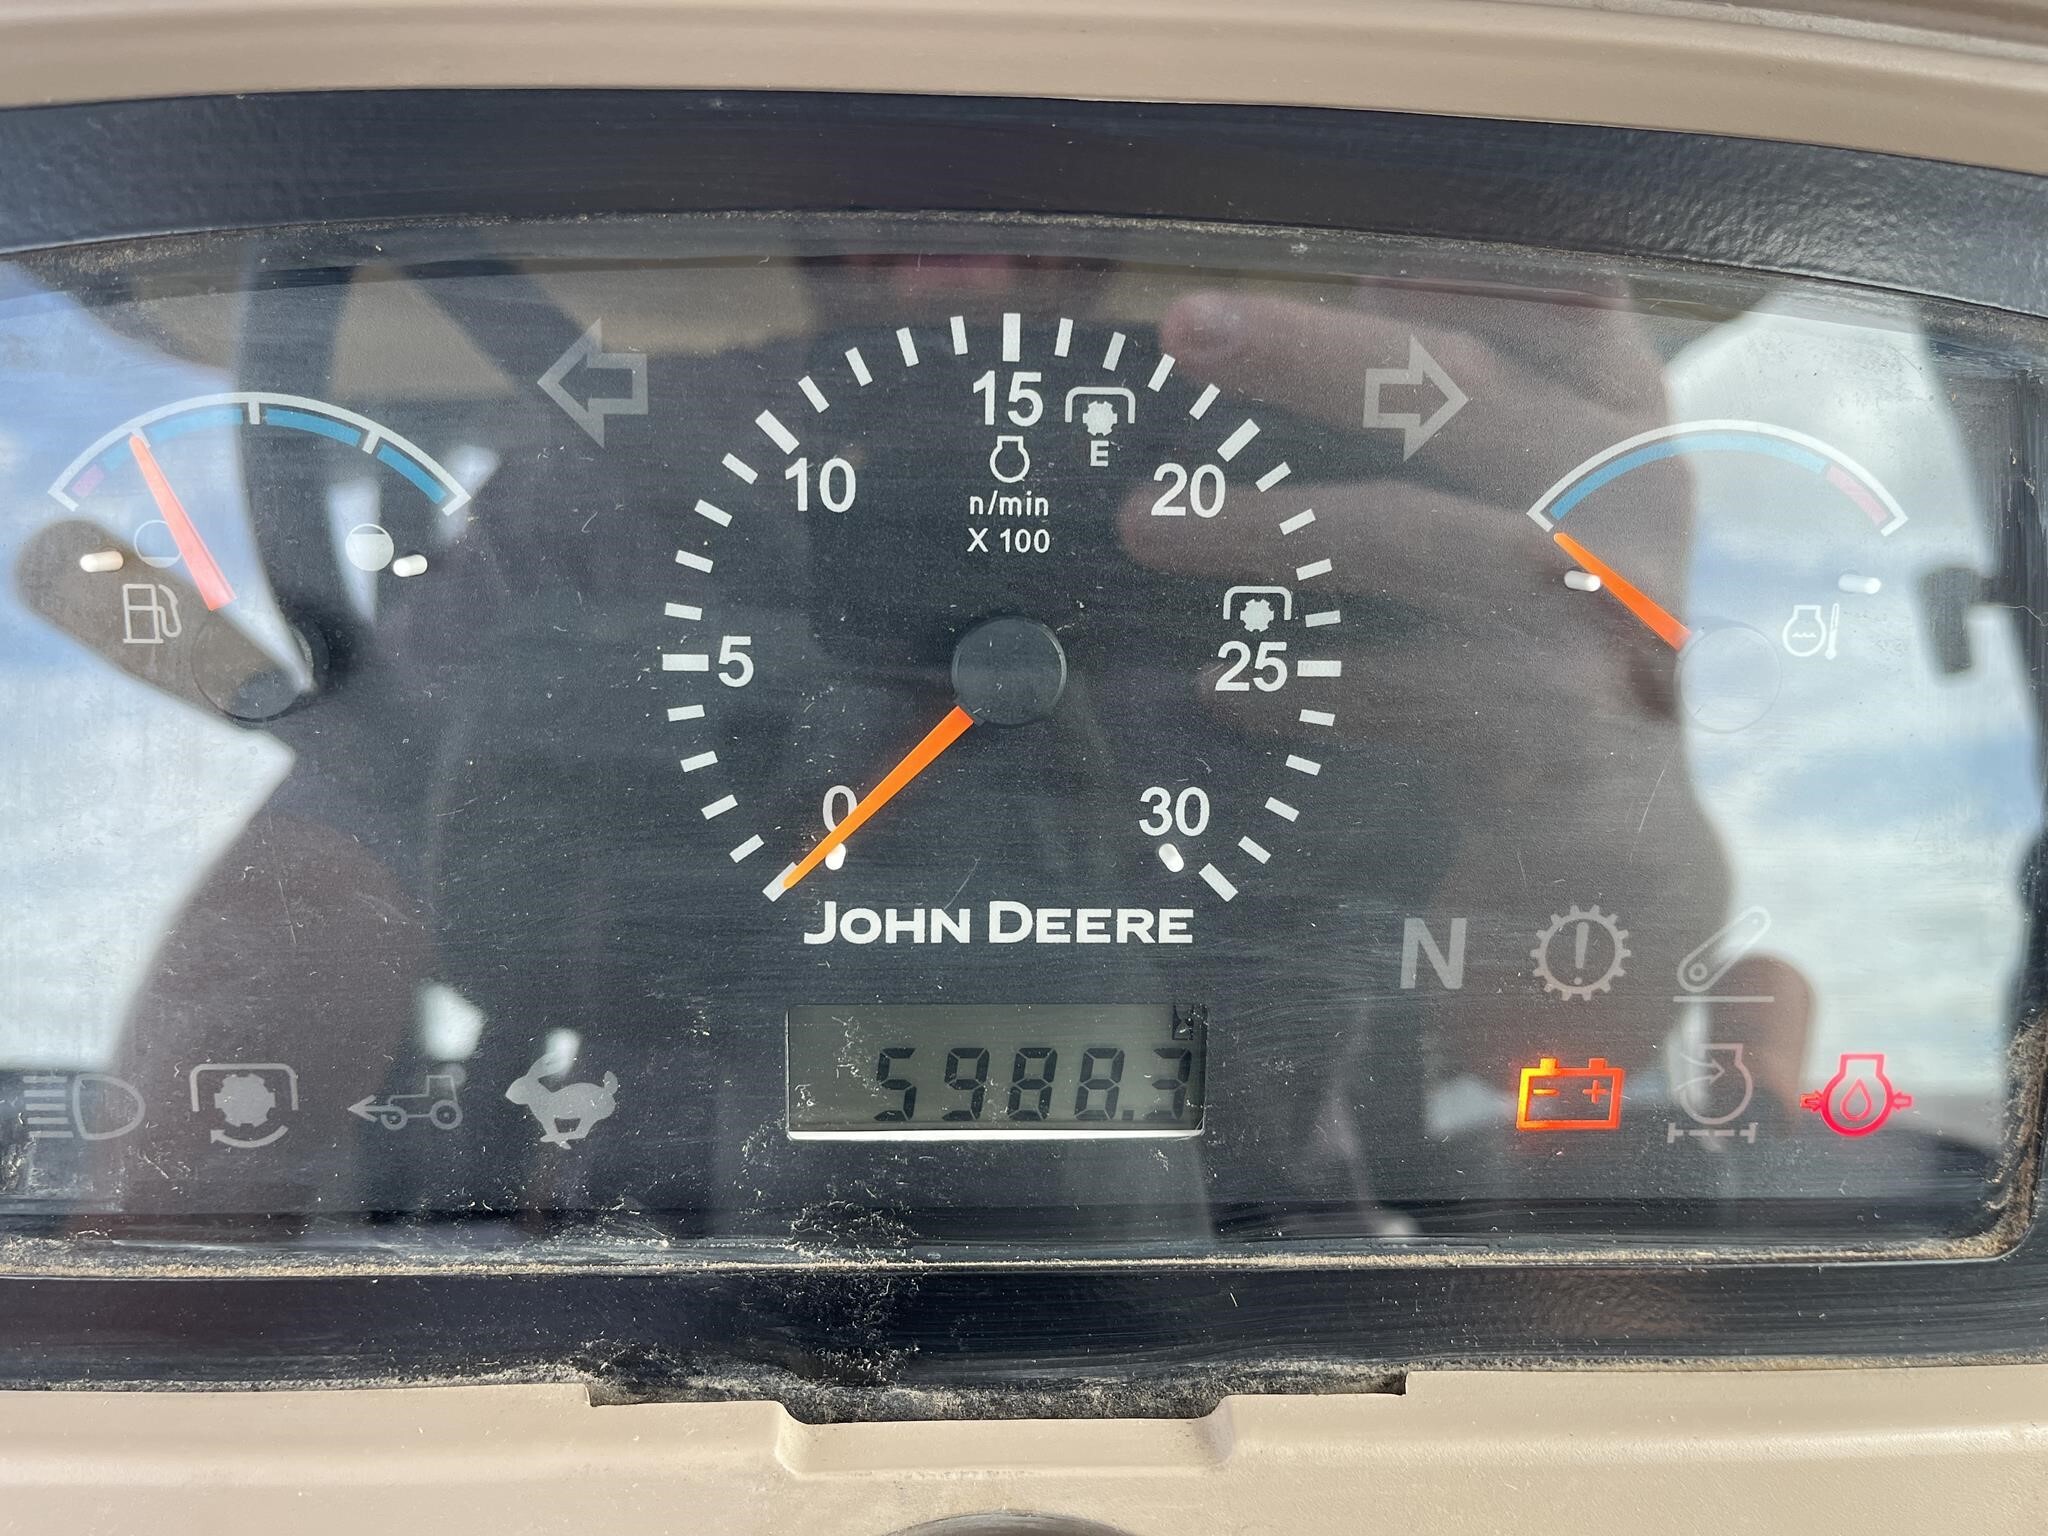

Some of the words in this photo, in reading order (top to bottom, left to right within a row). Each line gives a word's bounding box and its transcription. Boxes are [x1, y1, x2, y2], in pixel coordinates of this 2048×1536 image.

[973, 371, 1044, 428] 15
[1090, 440, 1109, 467] E
[784, 458, 857, 513] 10
[969, 492, 1050, 518] n/min
[1151, 463, 1227, 518] 20
[967, 529, 989, 553] X
[1000, 529, 1051, 553] 100
[717, 635, 755, 688] 5
[1215, 641, 1289, 692] 25
[822, 785, 859, 838] 0
[1139, 786, 1211, 838] 30
[803, 901, 971, 945] JOHN
[988, 901, 1195, 944] DEERE
[1399, 917, 1467, 990] N
[873, 1047, 1194, 1122] 5988.3
